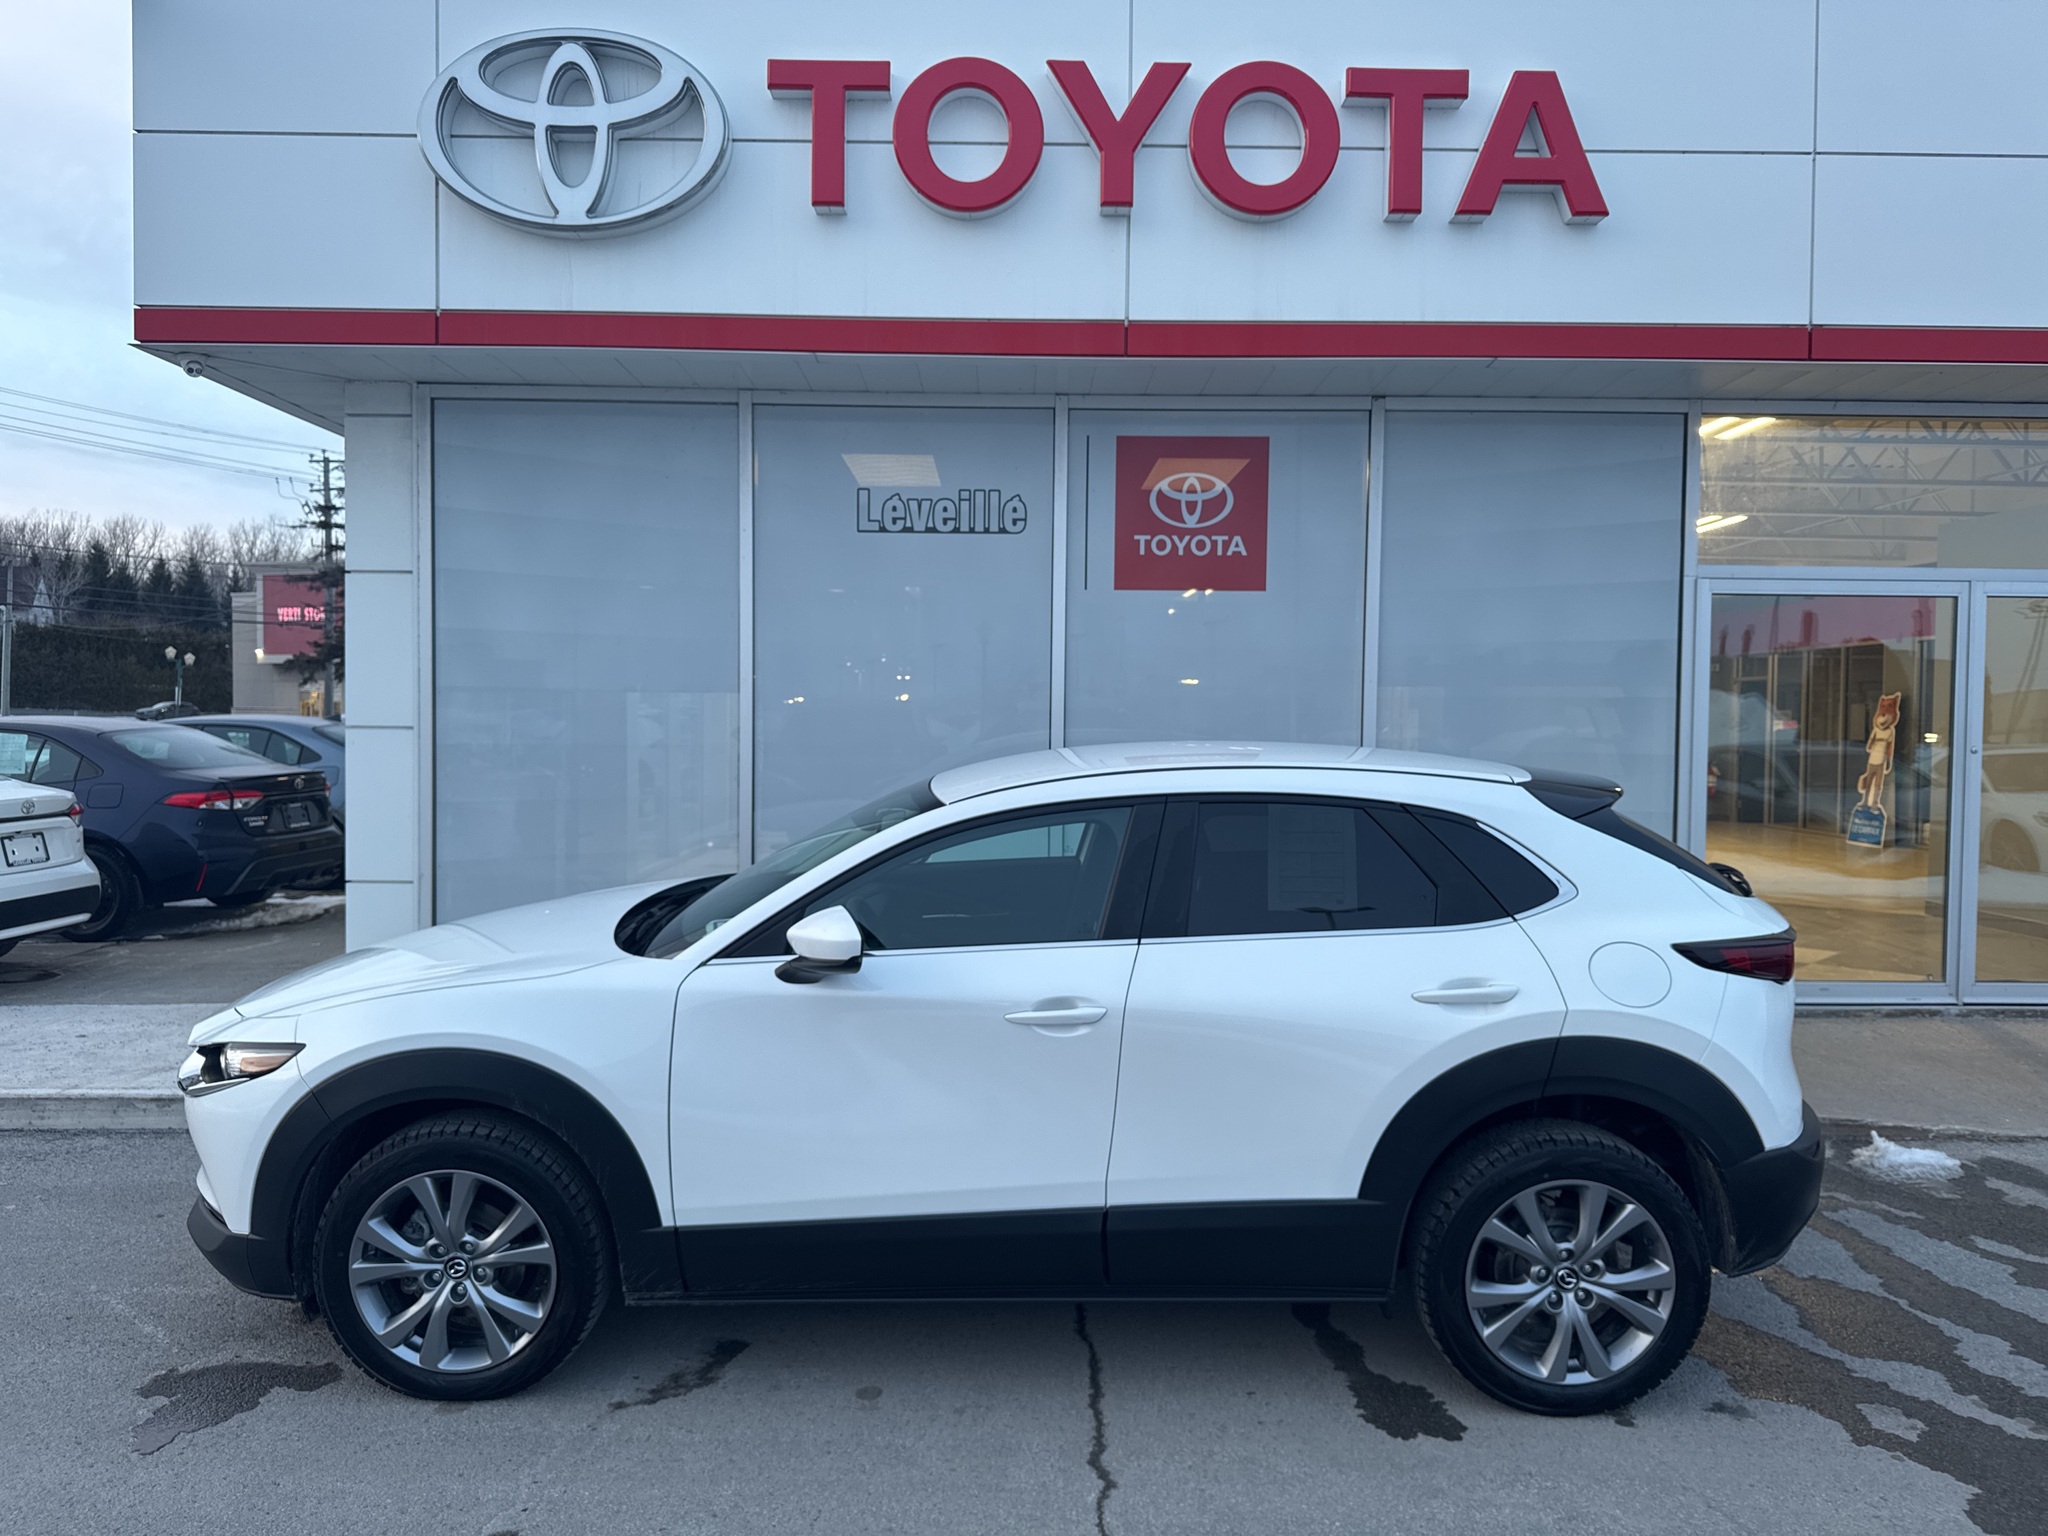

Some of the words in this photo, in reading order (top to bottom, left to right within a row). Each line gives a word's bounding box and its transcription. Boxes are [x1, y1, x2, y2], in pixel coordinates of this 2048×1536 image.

[767, 56, 1610, 225] TOYOTA
[856, 487, 1028, 535] Léveillé
[1133, 534, 1248, 557] TOYOTA
